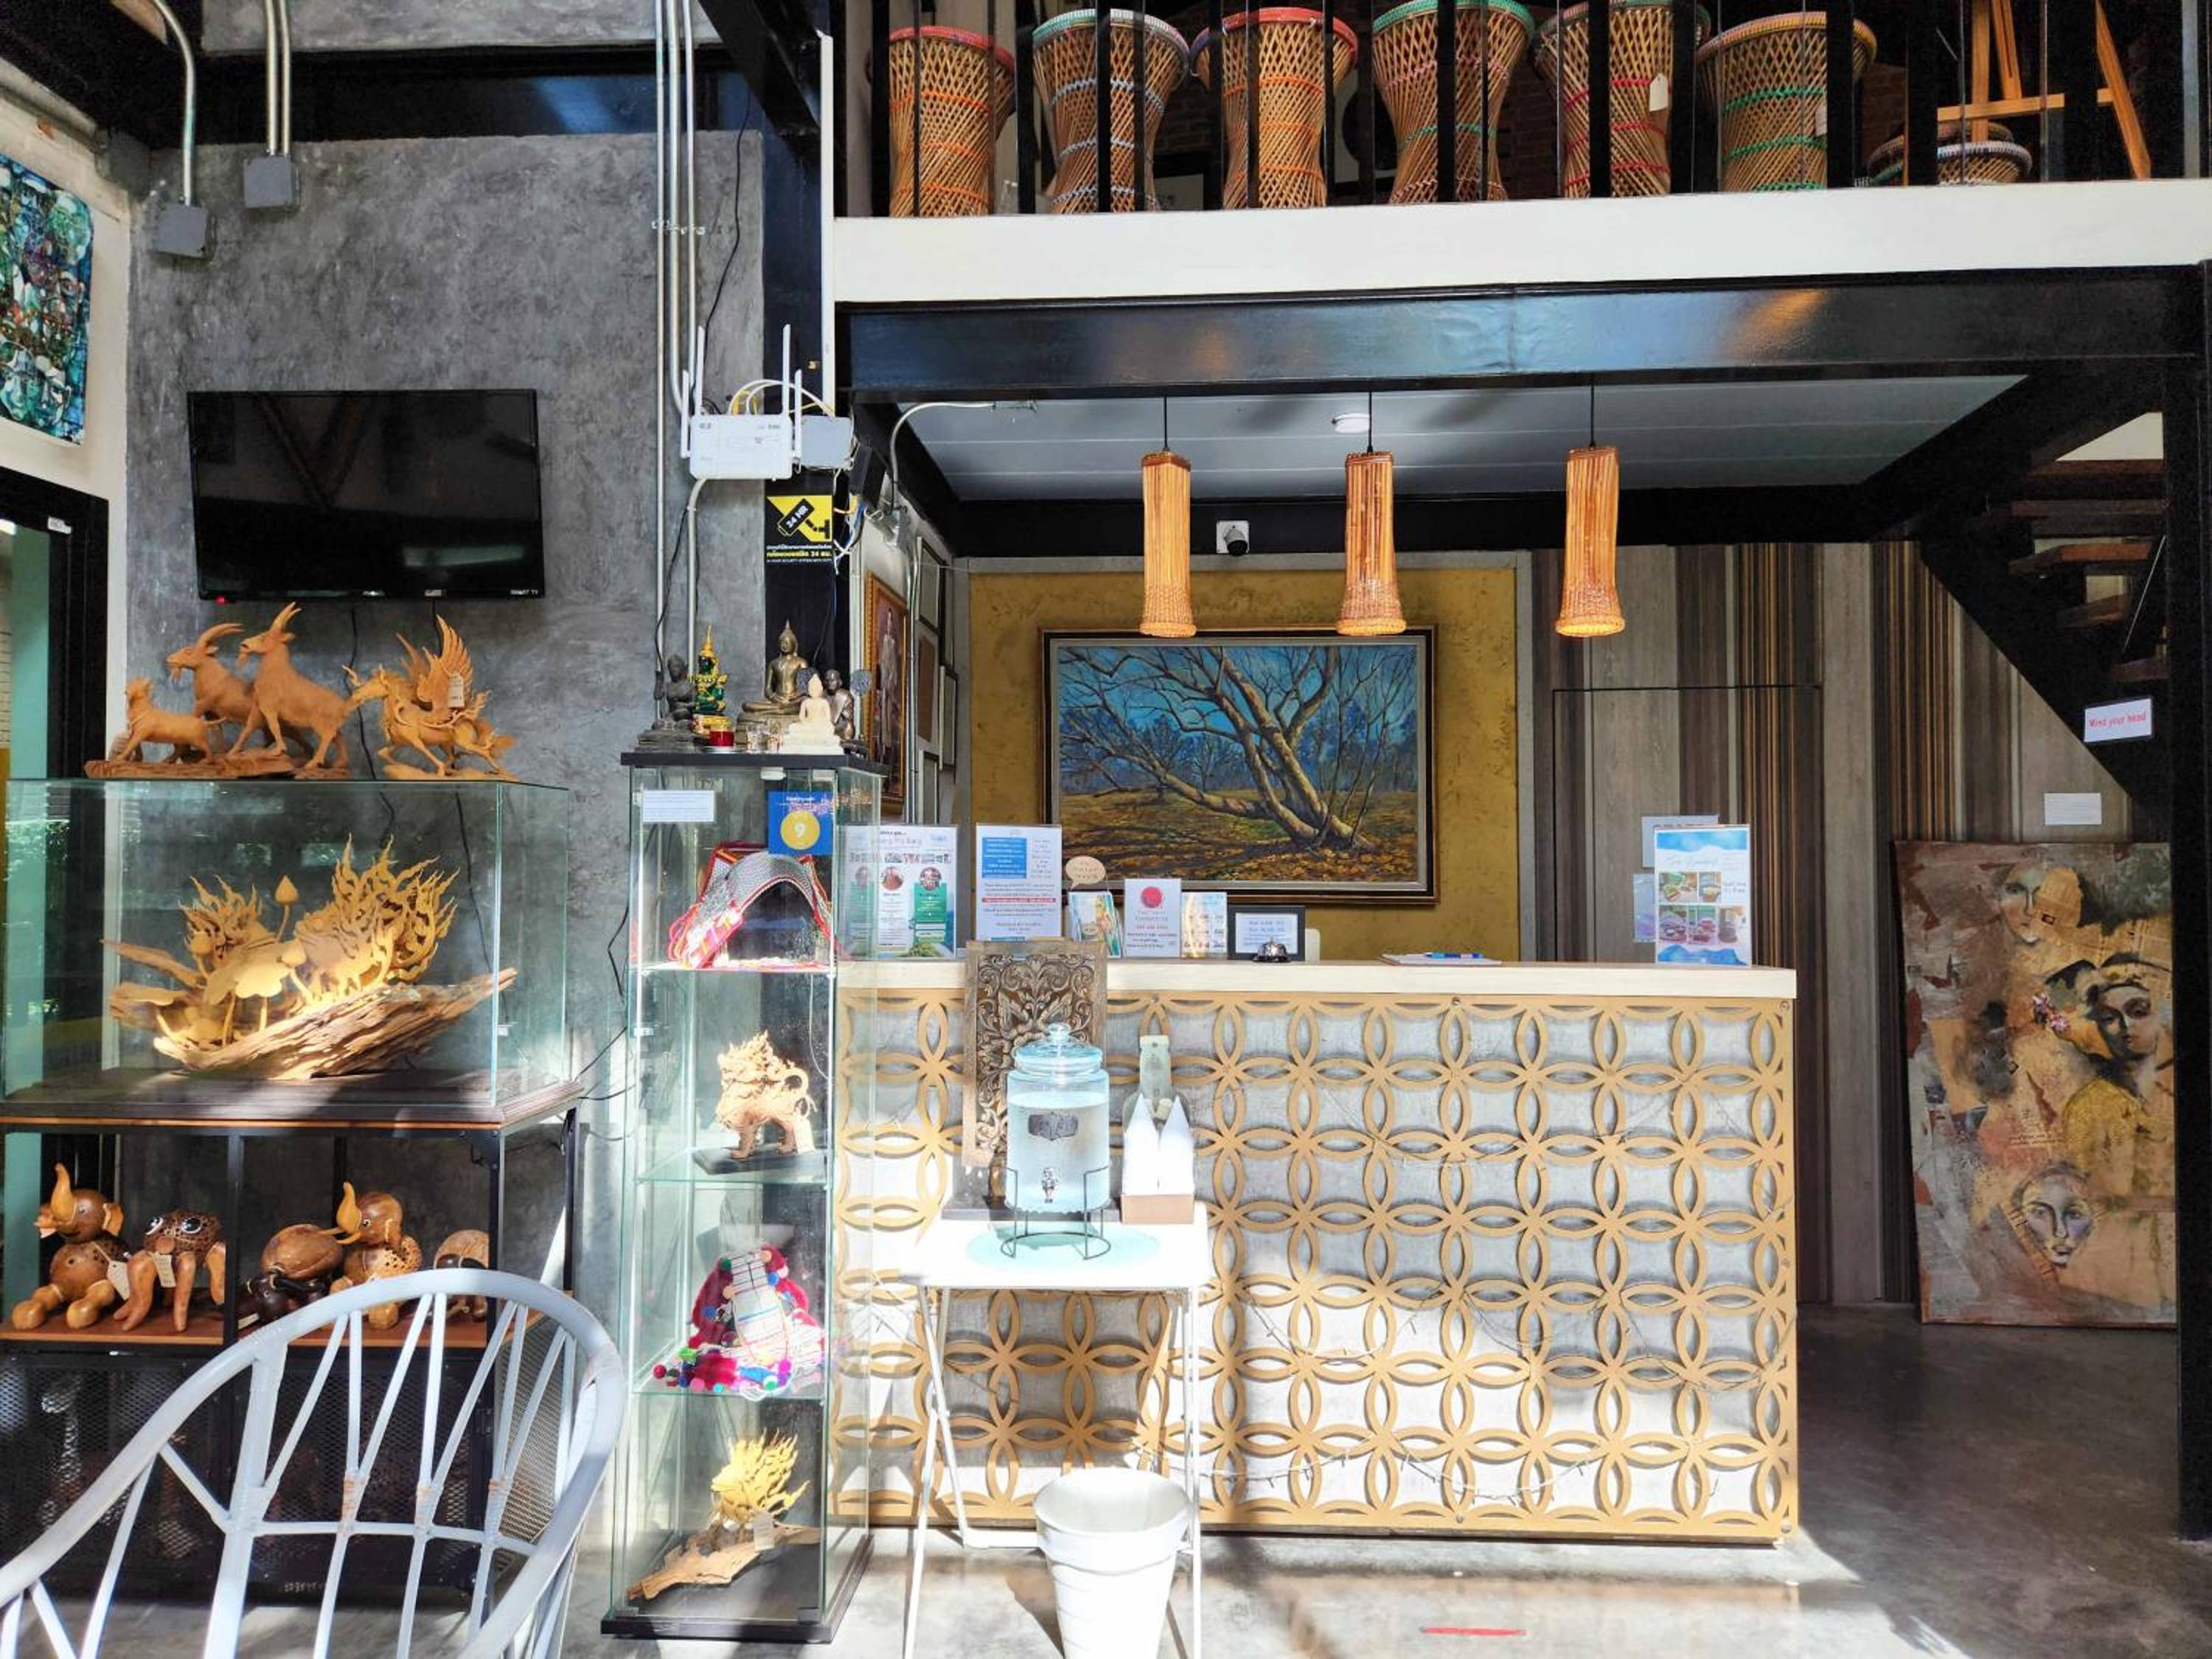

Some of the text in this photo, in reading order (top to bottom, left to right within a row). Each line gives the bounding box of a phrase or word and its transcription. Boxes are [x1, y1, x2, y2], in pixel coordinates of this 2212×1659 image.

[795, 505, 809, 518] HR
[2089, 717, 2107, 728] Mind
[2108, 717, 2125, 728] your
